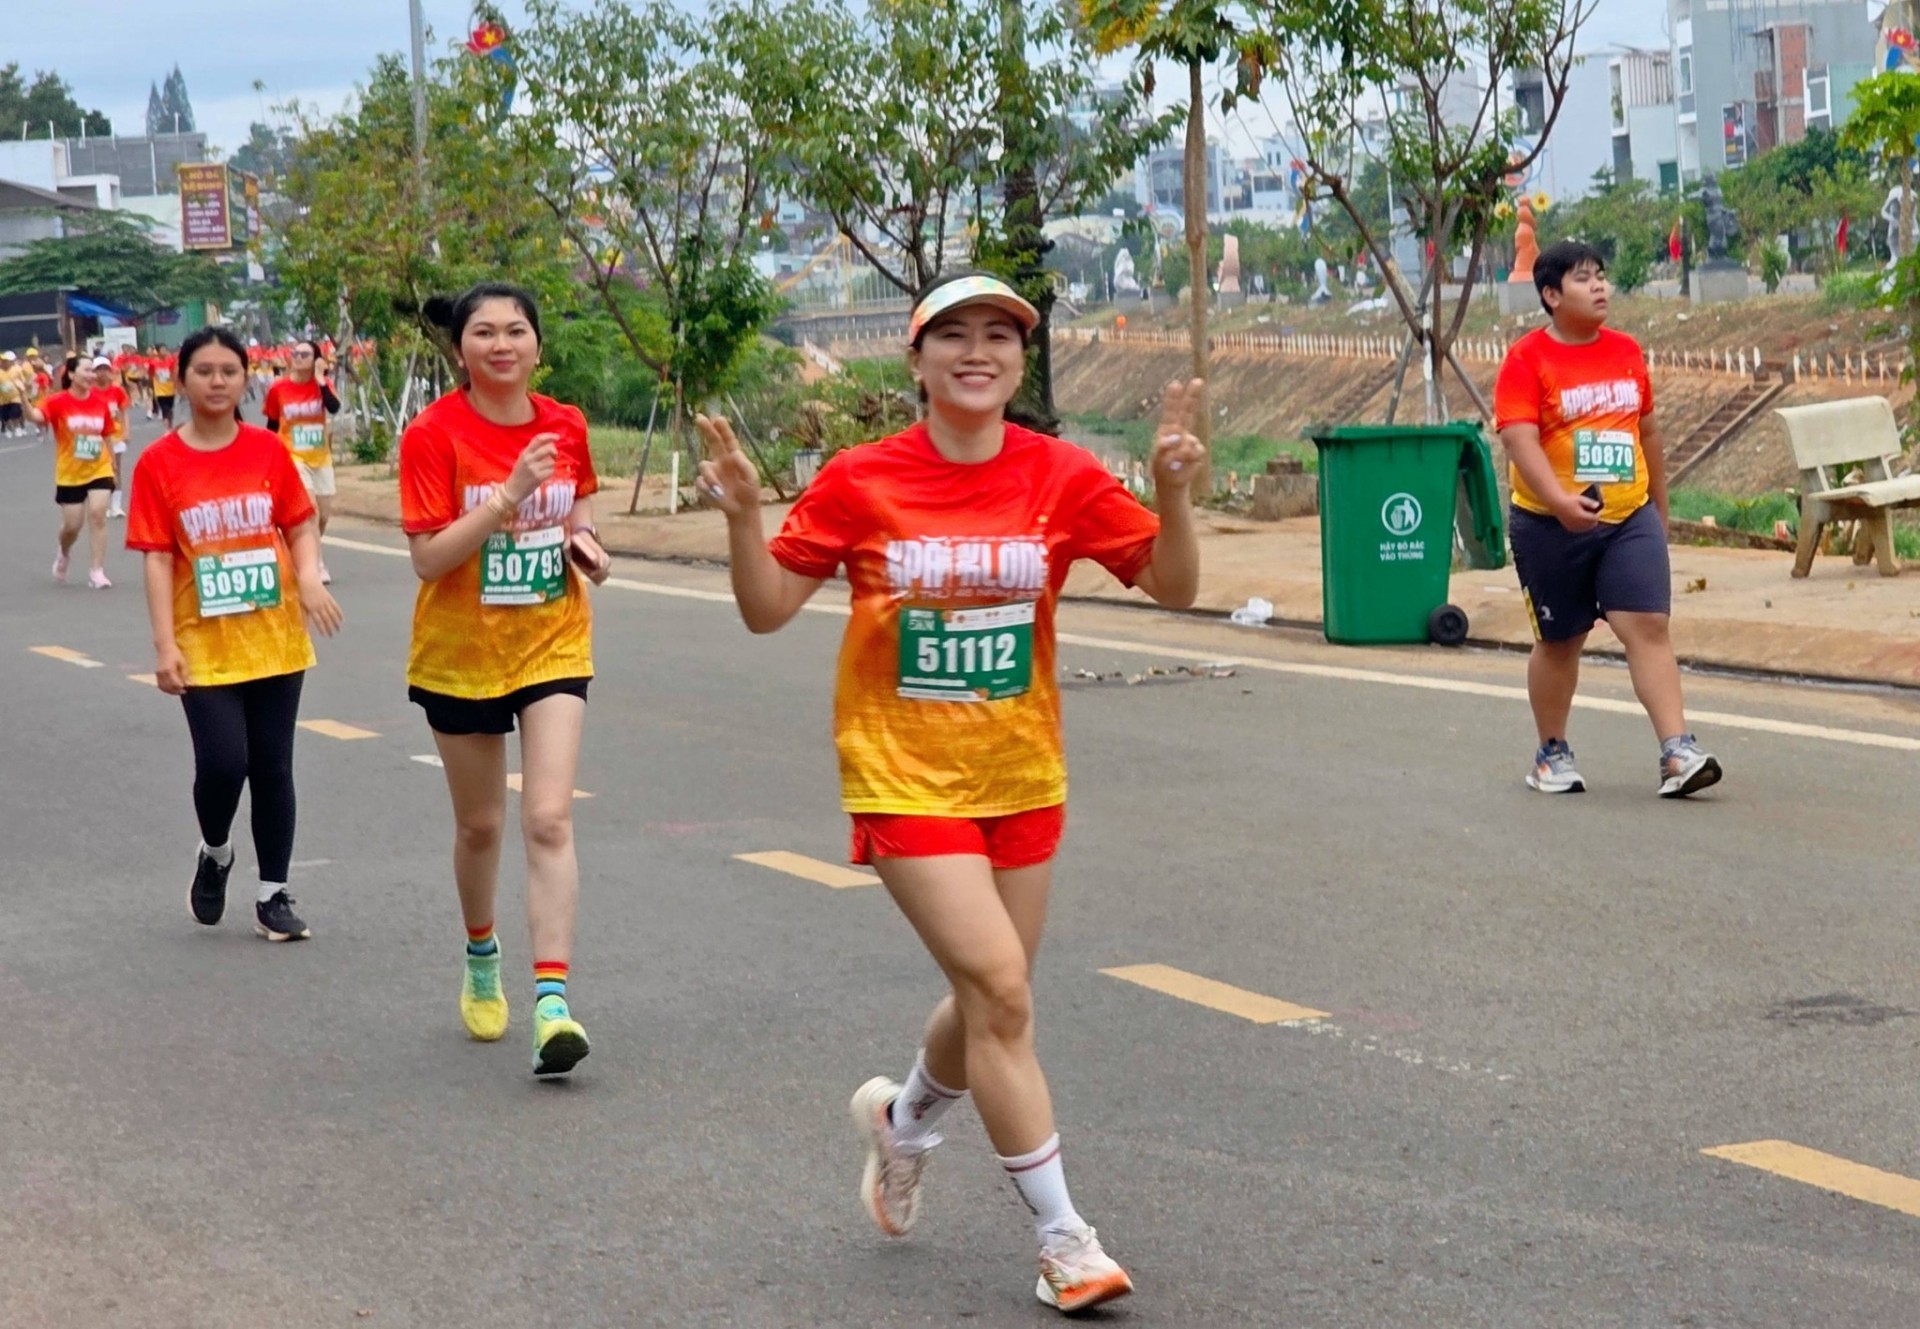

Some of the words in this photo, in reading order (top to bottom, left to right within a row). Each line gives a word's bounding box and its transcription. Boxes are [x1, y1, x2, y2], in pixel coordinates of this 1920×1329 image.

[1578, 445, 1634, 467] 50870
[201, 565, 275, 598] 50970
[487, 547, 563, 583] 50793
[917, 633, 1017, 673] 51112
